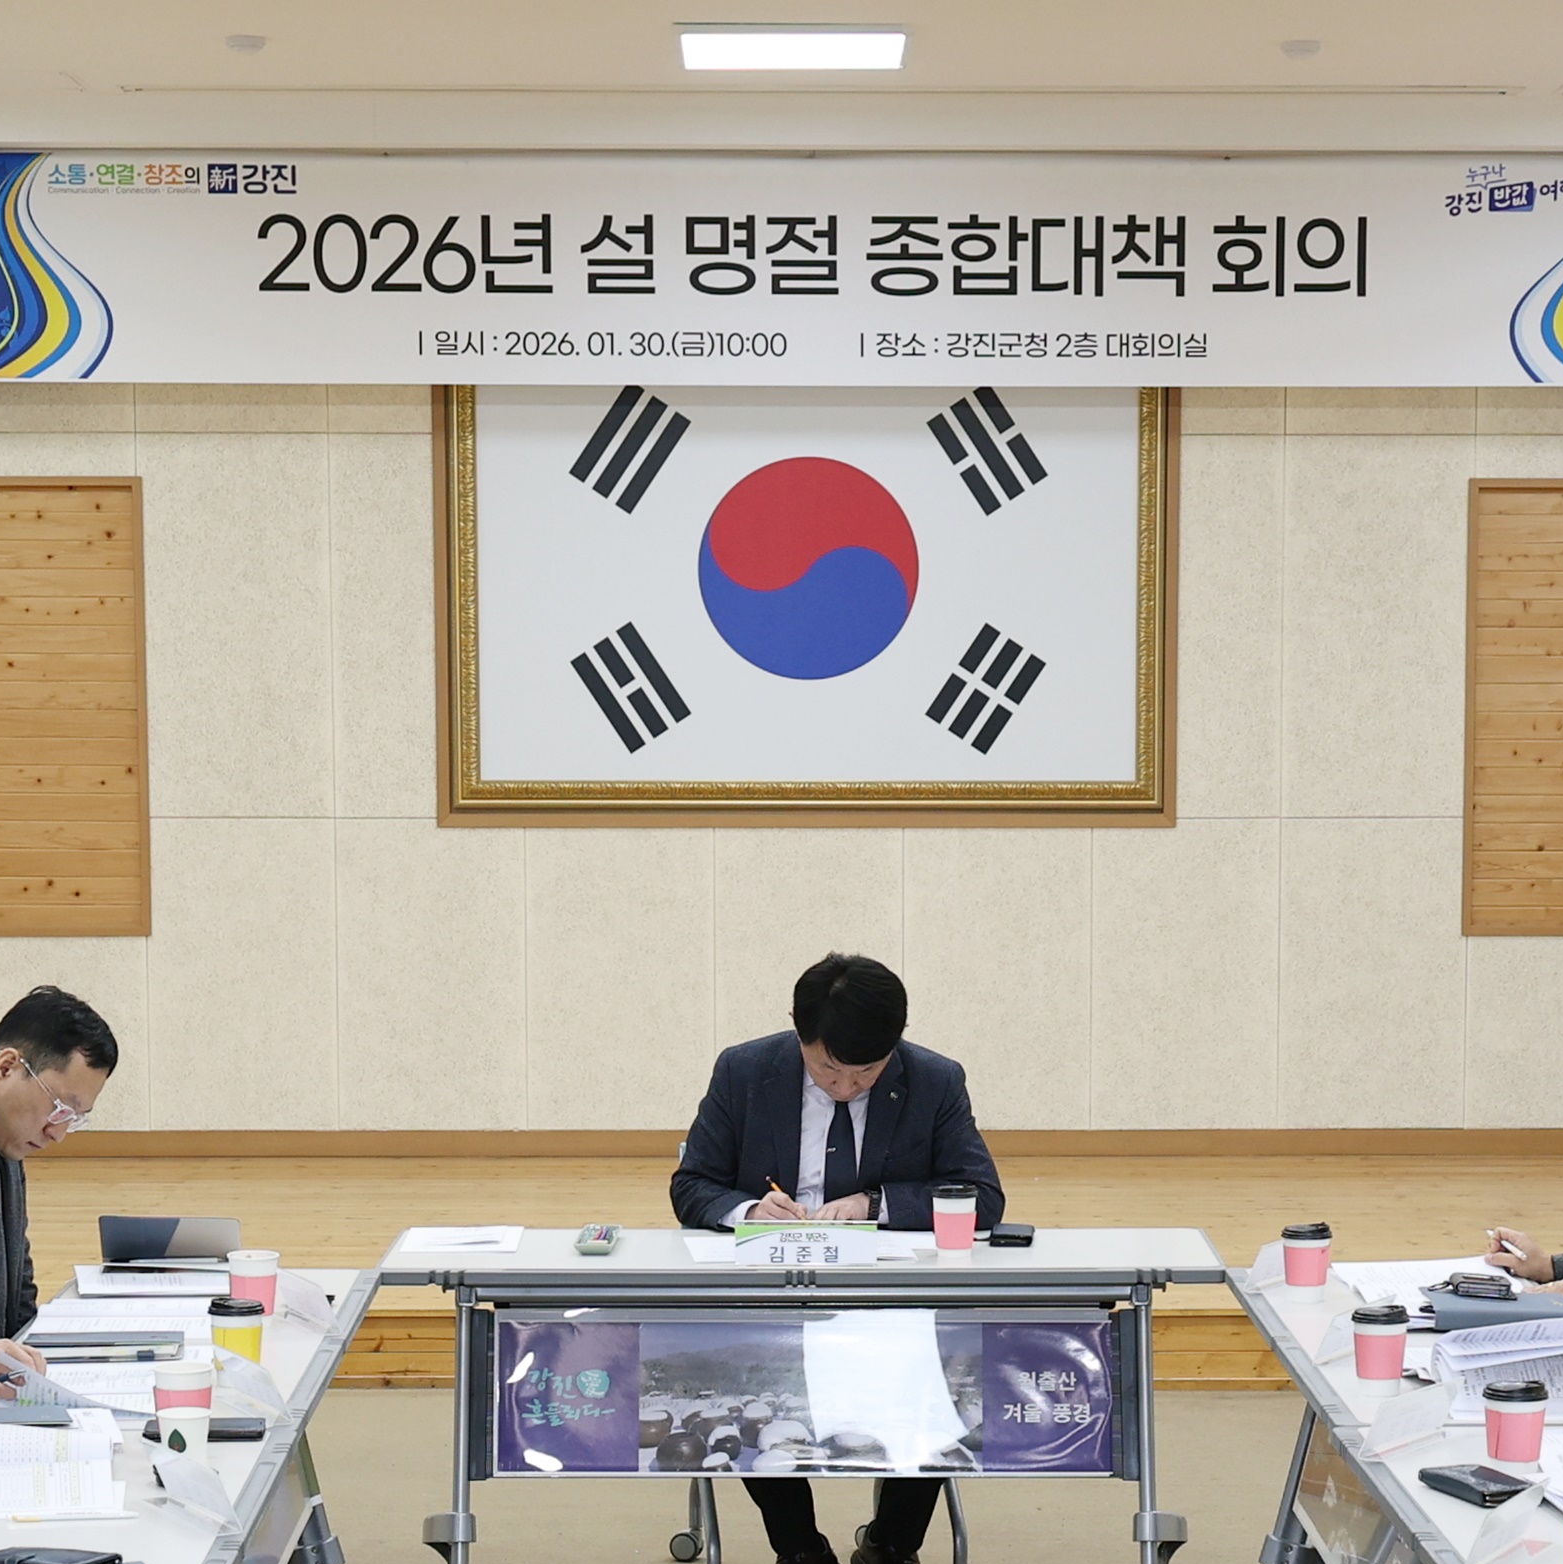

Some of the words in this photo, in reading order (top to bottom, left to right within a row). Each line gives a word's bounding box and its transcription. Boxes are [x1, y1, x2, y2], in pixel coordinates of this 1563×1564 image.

[208, 164, 238, 194] 新
[241, 164, 298, 195] 강진
[1466, 163, 1507, 183] 누구나
[115, 186, 161, 194] Connection
[166, 186, 201, 194] Creation
[1444, 190, 1483, 217] 강진
[1492, 184, 1529, 208] 반값
[257, 213, 554, 295] 2026년
[580, 213, 656, 295] 설
[685, 214, 840, 296] 명절
[865, 213, 1187, 298] 종합대책
[1211, 214, 1368, 298] 회의
[434, 330, 485, 357] 일시
[504, 330, 581, 357] 2026.
[587, 330, 623, 357] 01.
[875, 332, 927, 358] 장소
[946, 332, 1048, 359] 강진군청
[1055, 331, 1099, 359] 2층
[1105, 332, 1208, 359] 대회의실
[528, 1367, 577, 1400] 강진
[1017, 1370, 1078, 1392] 월출산
[1002, 1402, 1043, 1424] 겨울
[1051, 1402, 1092, 1424] 풍경
